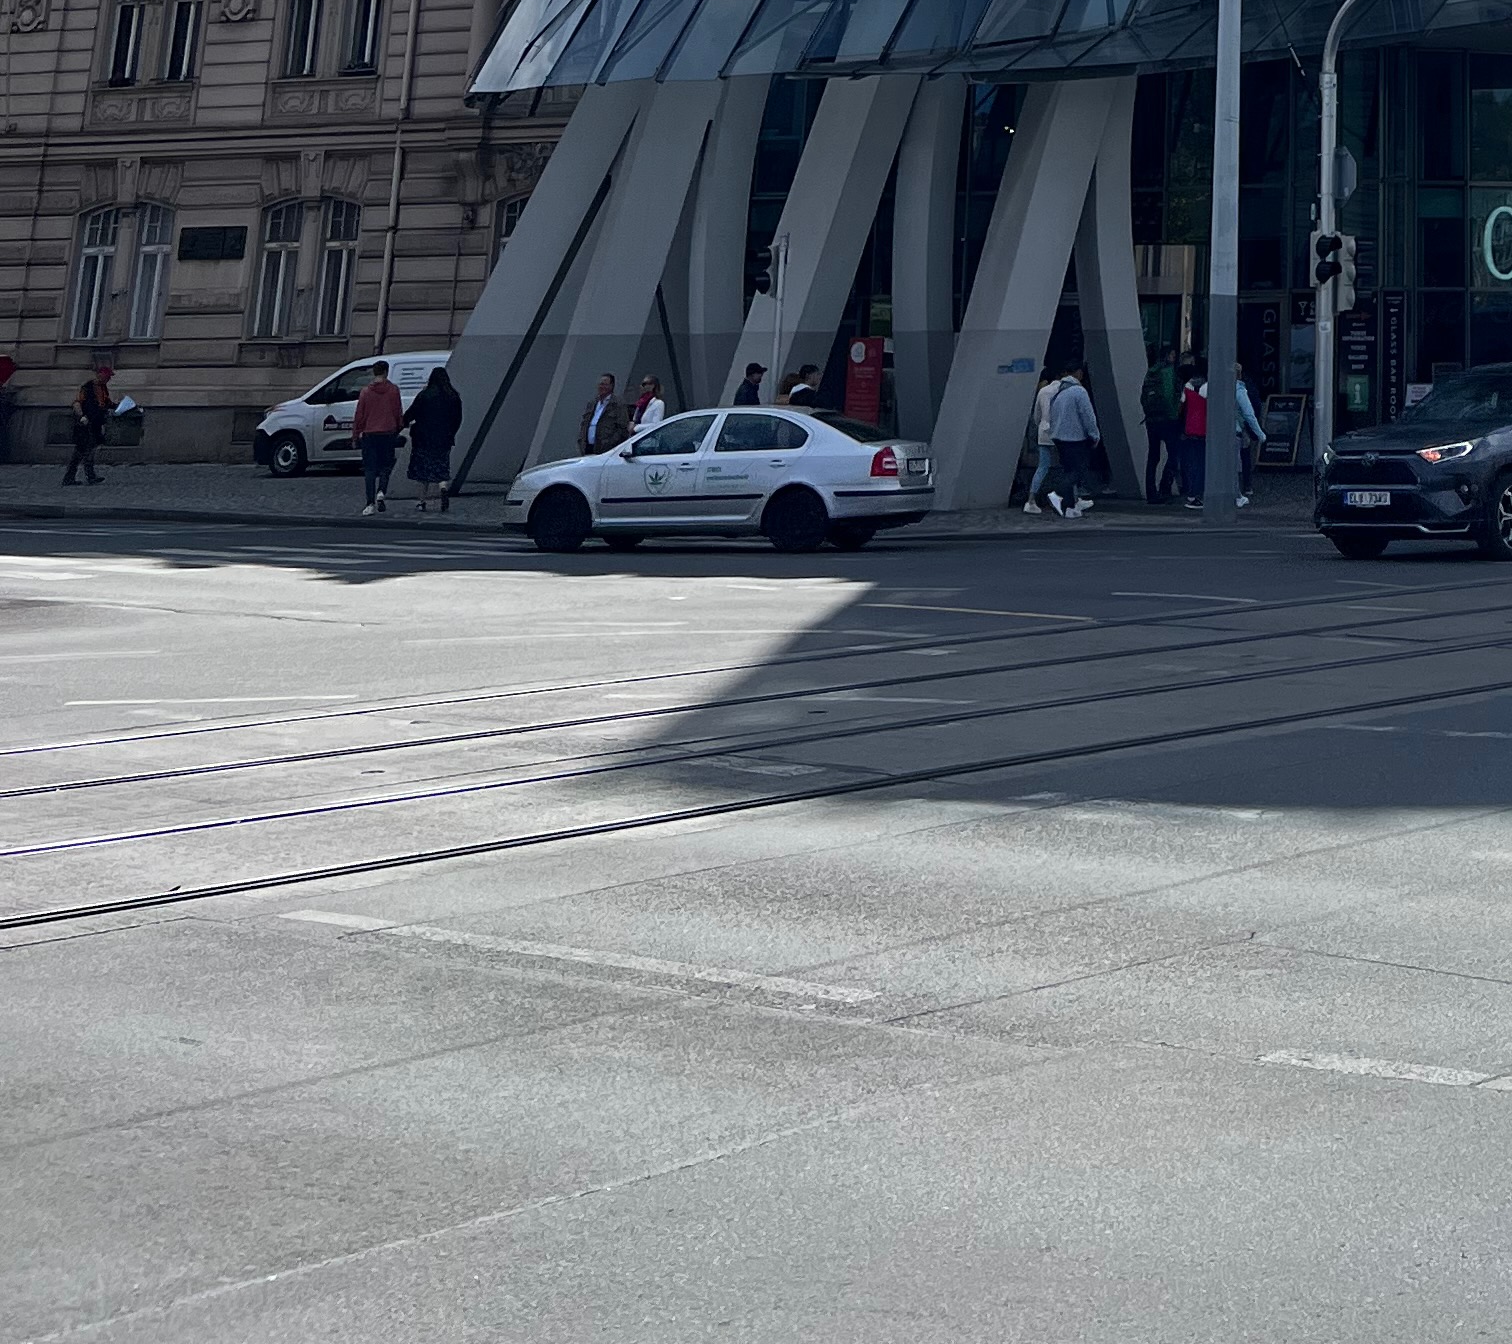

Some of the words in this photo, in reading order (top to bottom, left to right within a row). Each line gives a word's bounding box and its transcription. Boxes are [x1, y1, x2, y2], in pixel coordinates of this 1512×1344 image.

[1262, 308, 1277, 388] GLASS
[1389, 318, 1398, 355] GLASS
[1389, 359, 1398, 383] BAR
